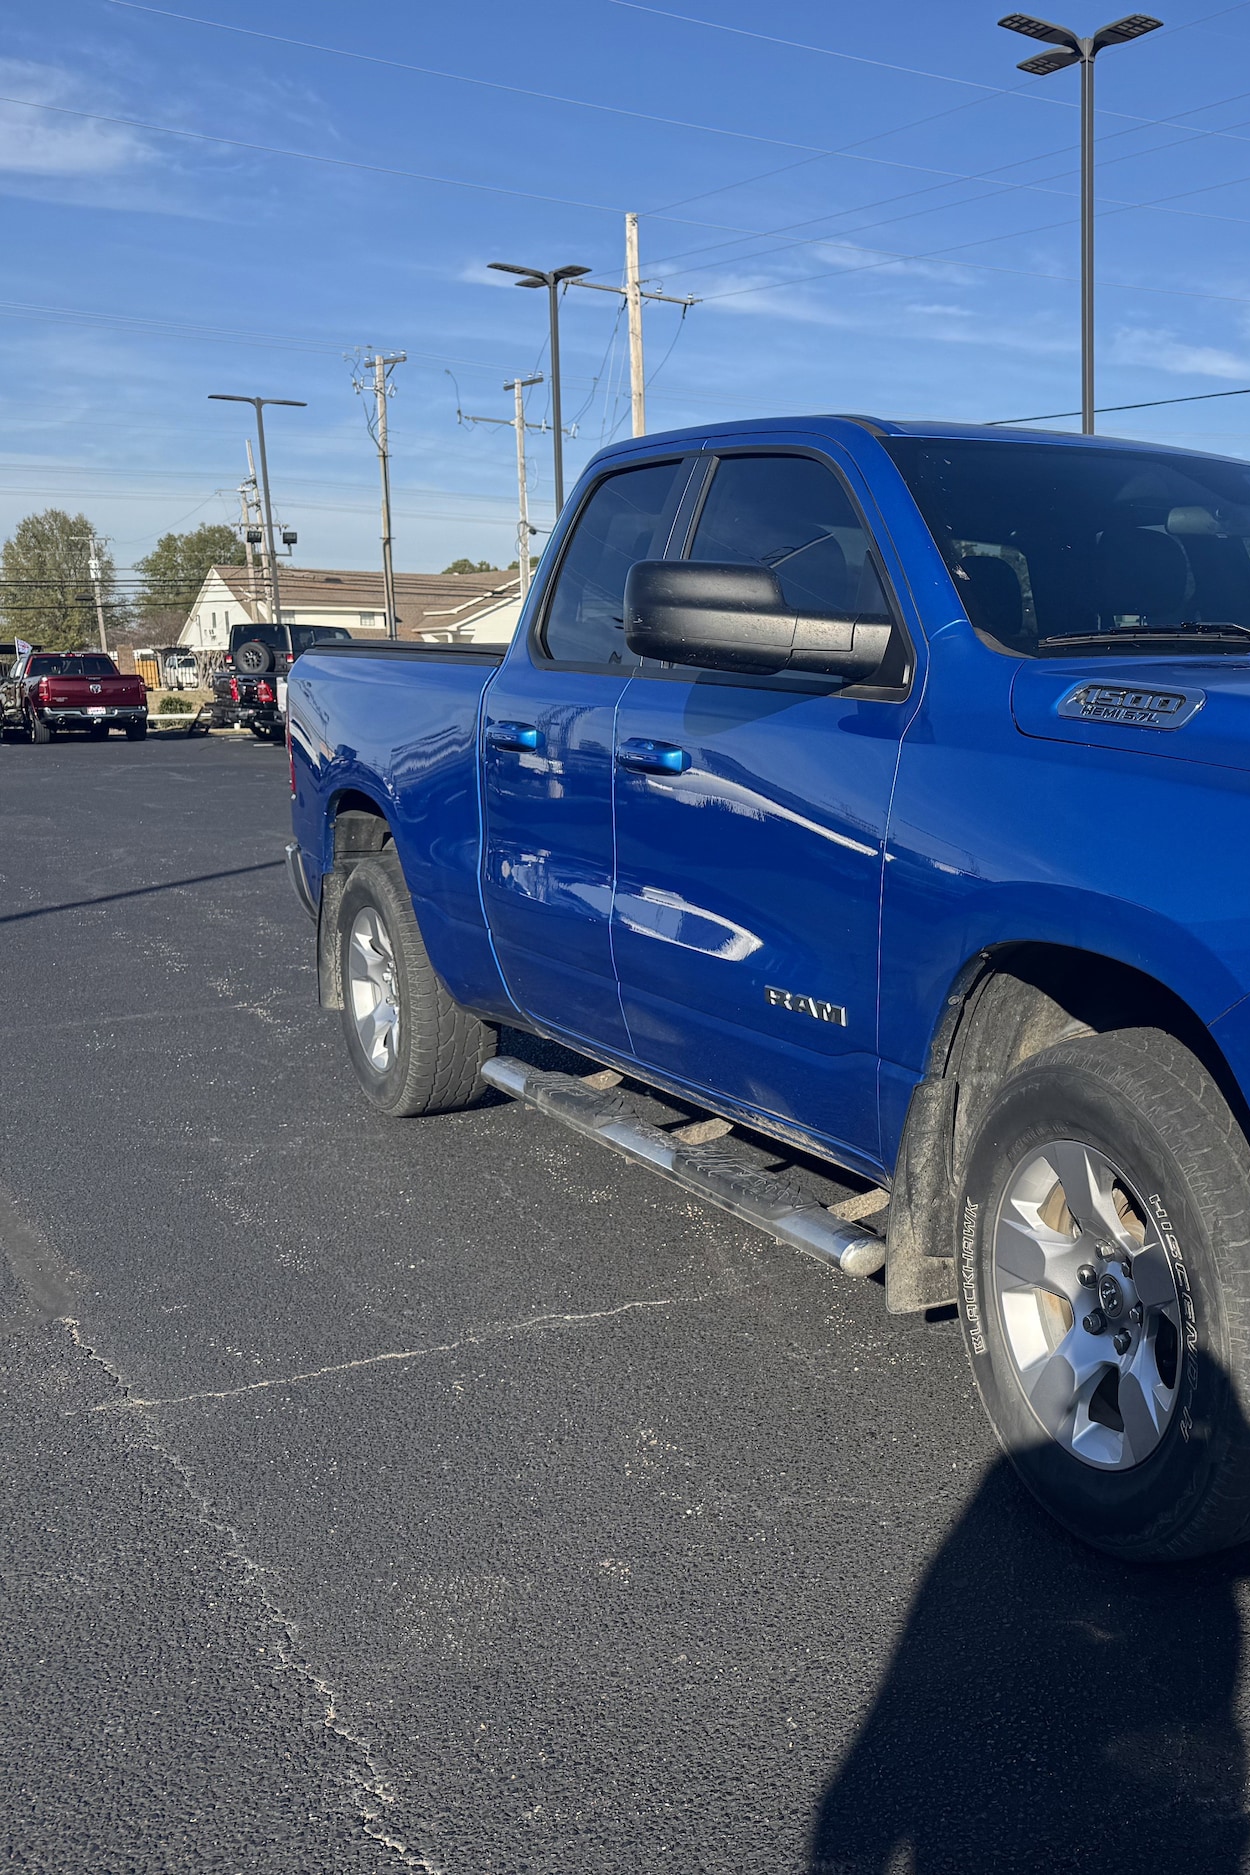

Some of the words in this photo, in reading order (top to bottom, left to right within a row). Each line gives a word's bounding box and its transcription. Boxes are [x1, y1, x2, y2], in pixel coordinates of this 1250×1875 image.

[1079, 704, 1120, 720] HEMI
[1085, 687, 1181, 713] 1500
[764, 985, 848, 1028] RAM
[962, 1195, 987, 1355] BLACKHAWK
